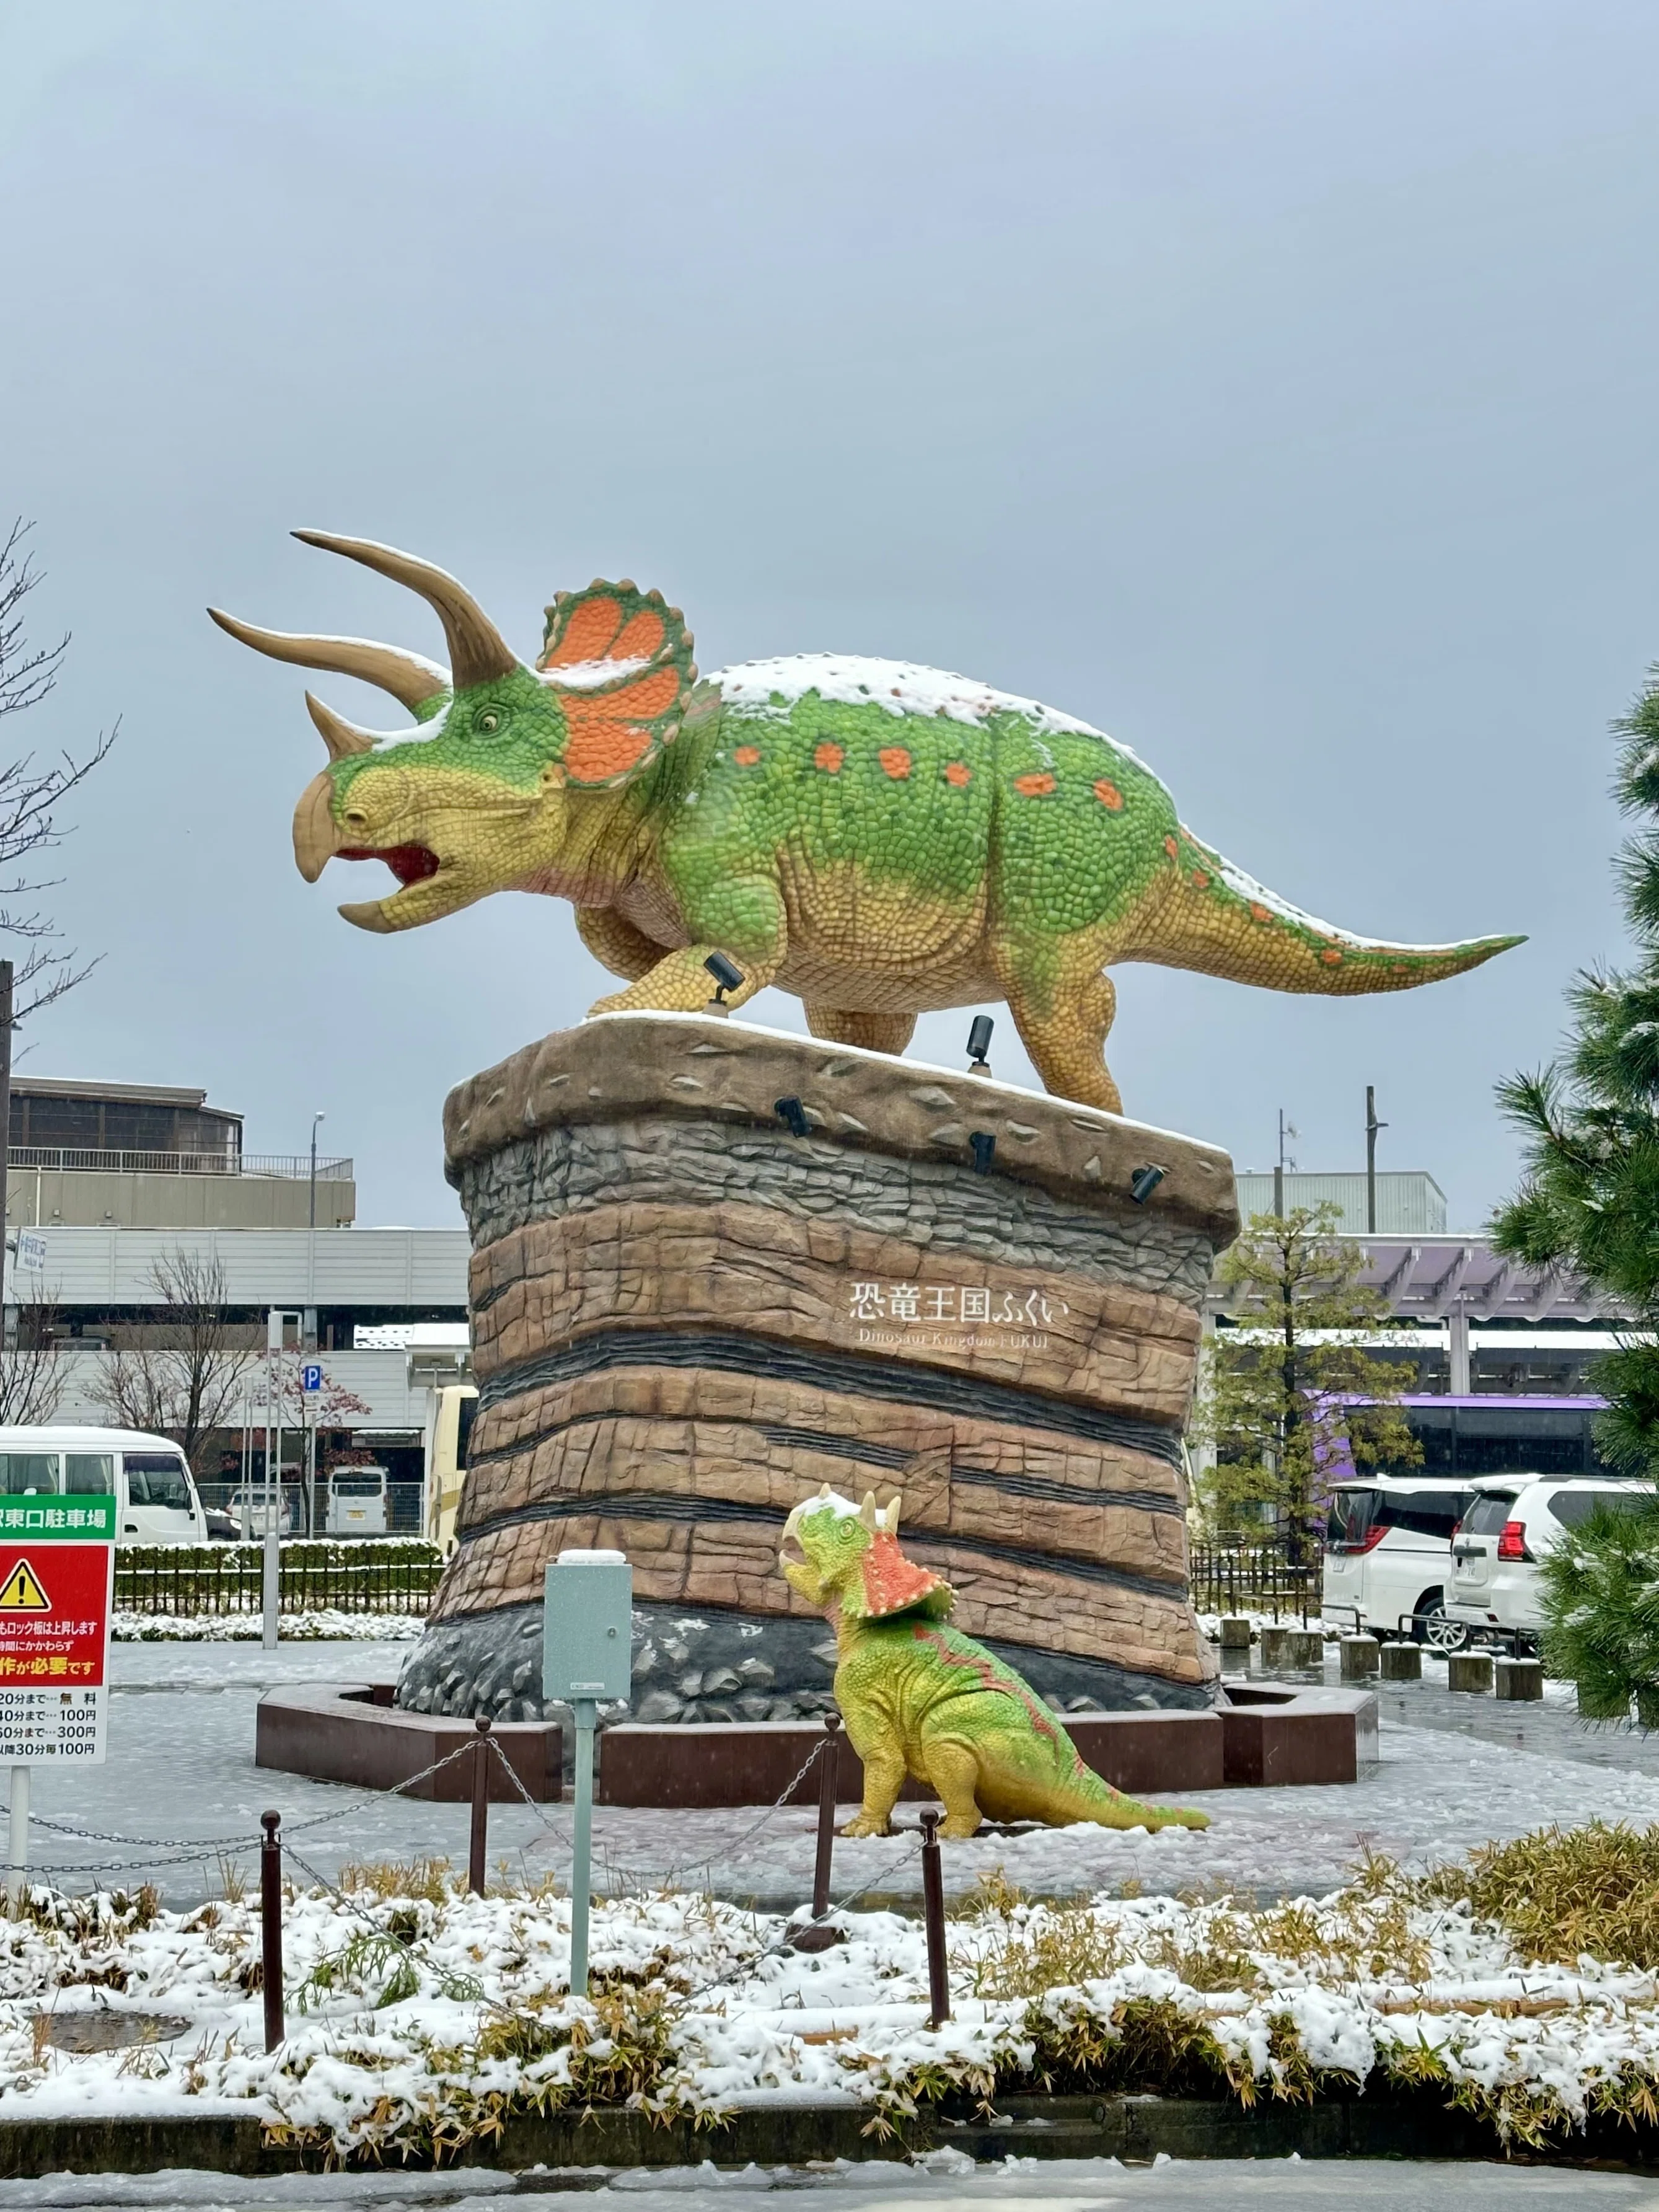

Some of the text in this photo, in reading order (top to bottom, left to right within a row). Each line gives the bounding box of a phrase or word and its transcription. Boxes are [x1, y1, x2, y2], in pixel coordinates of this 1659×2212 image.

[849, 1281, 1069, 1326] 恐竜王国ふくい
[859, 1328, 1048, 1349] Dinosaur Kingdom FUKUI
[308, 1368, 319, 1388] P
[0, 1509, 107, 1528] 東口駐車場
